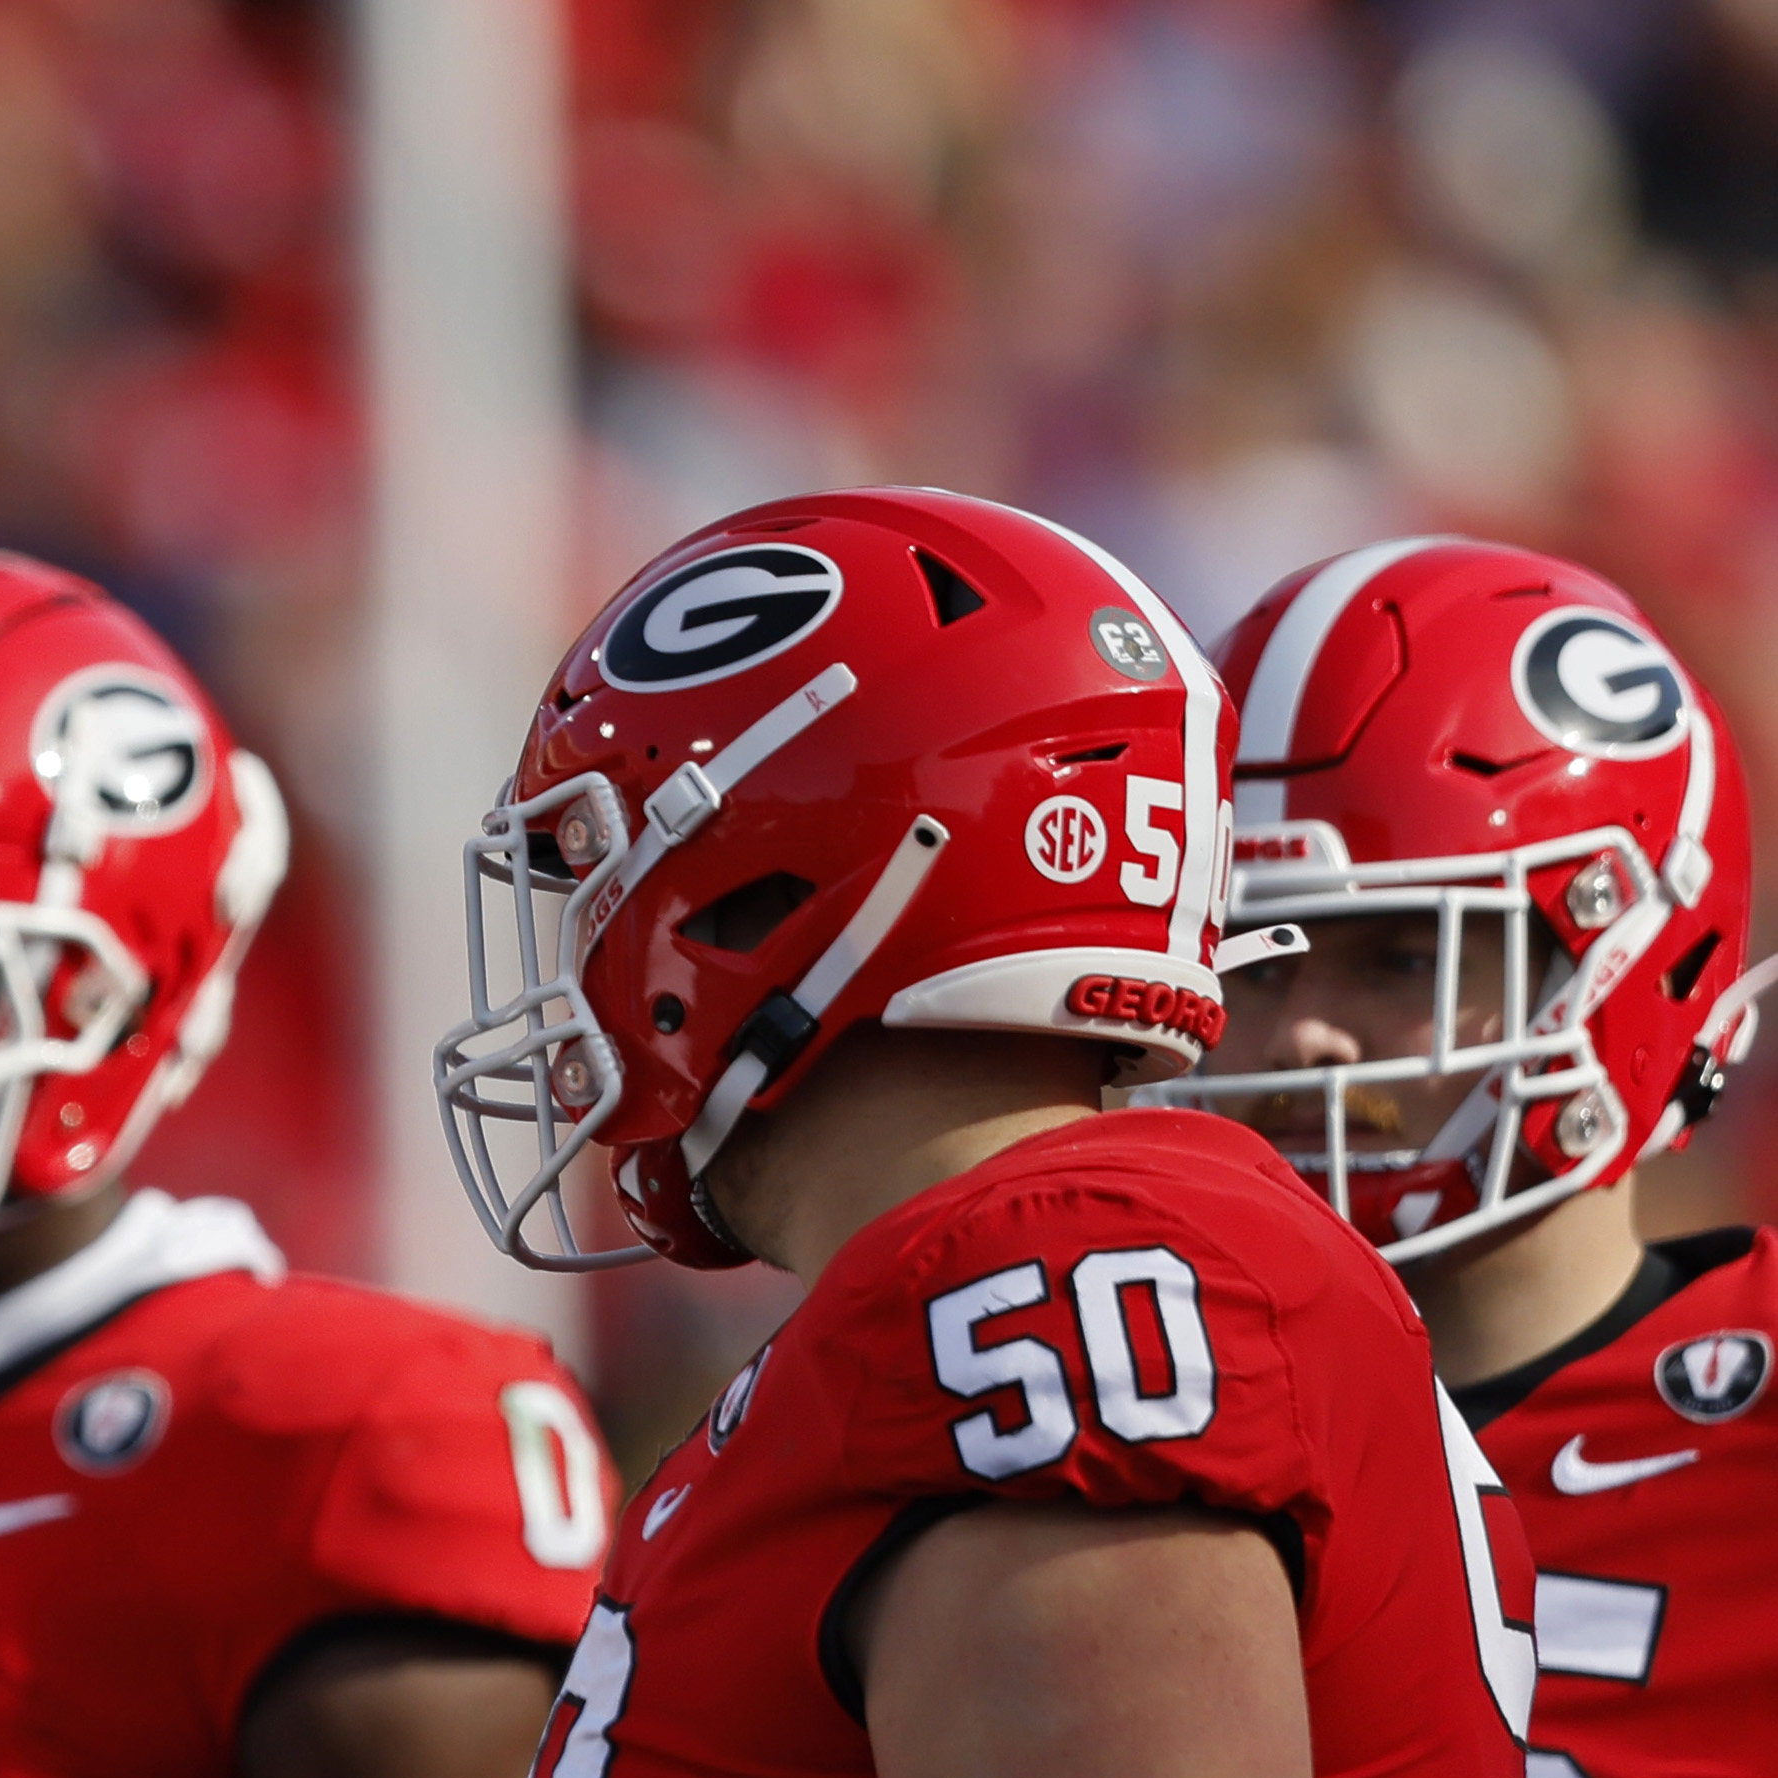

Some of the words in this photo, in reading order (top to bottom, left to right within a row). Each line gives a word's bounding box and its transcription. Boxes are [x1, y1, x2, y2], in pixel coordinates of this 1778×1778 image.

[603, 548, 834, 683] G
[1525, 617, 1684, 743] G
[1033, 803, 1101, 876] SEC
[926, 1245, 1216, 1481] 50
[500, 1379, 610, 1568] 0
